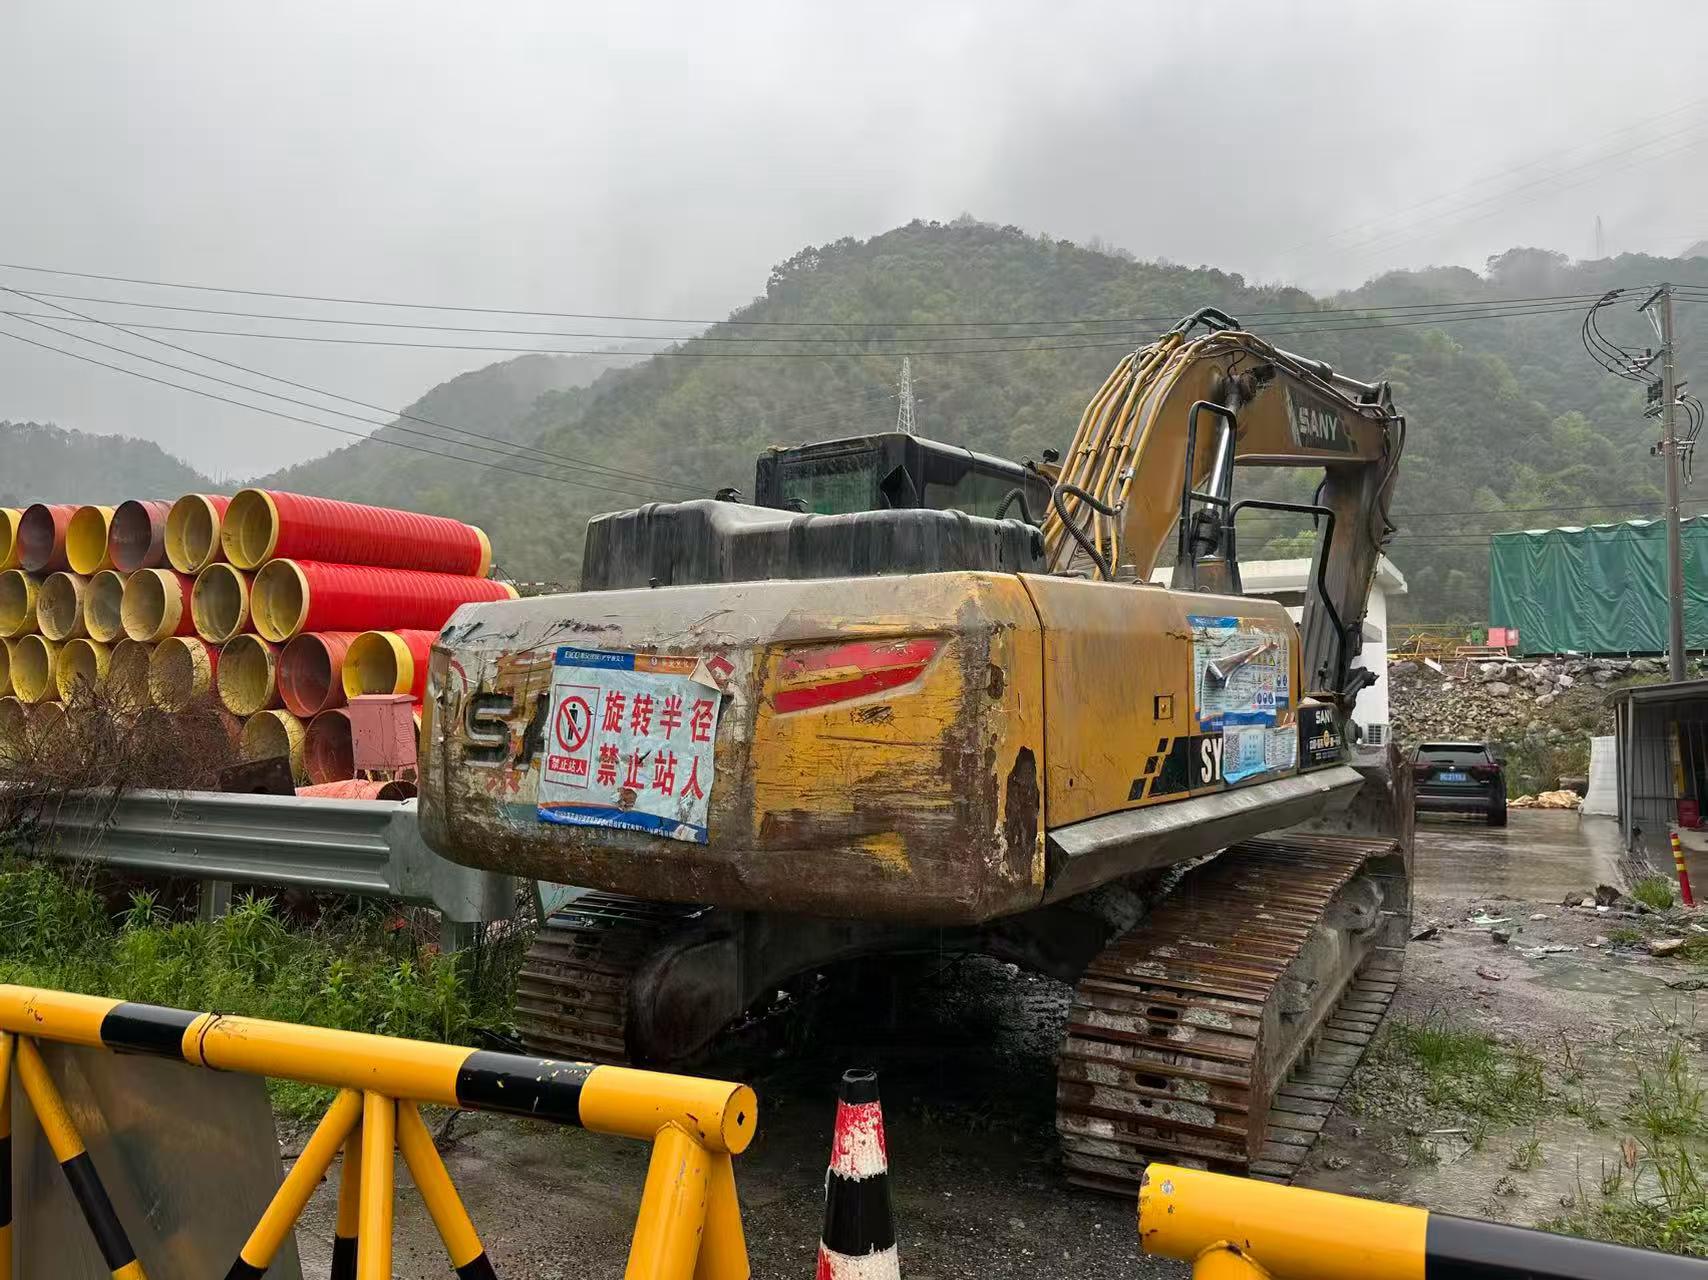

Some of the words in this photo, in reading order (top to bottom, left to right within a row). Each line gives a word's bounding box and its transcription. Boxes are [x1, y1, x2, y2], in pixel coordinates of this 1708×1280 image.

[1299, 407, 1338, 440] SANY
[602, 690, 715, 743] 旋转半径
[551, 756, 585, 774] 禁止站人
[597, 743, 704, 800] 禁止站人
